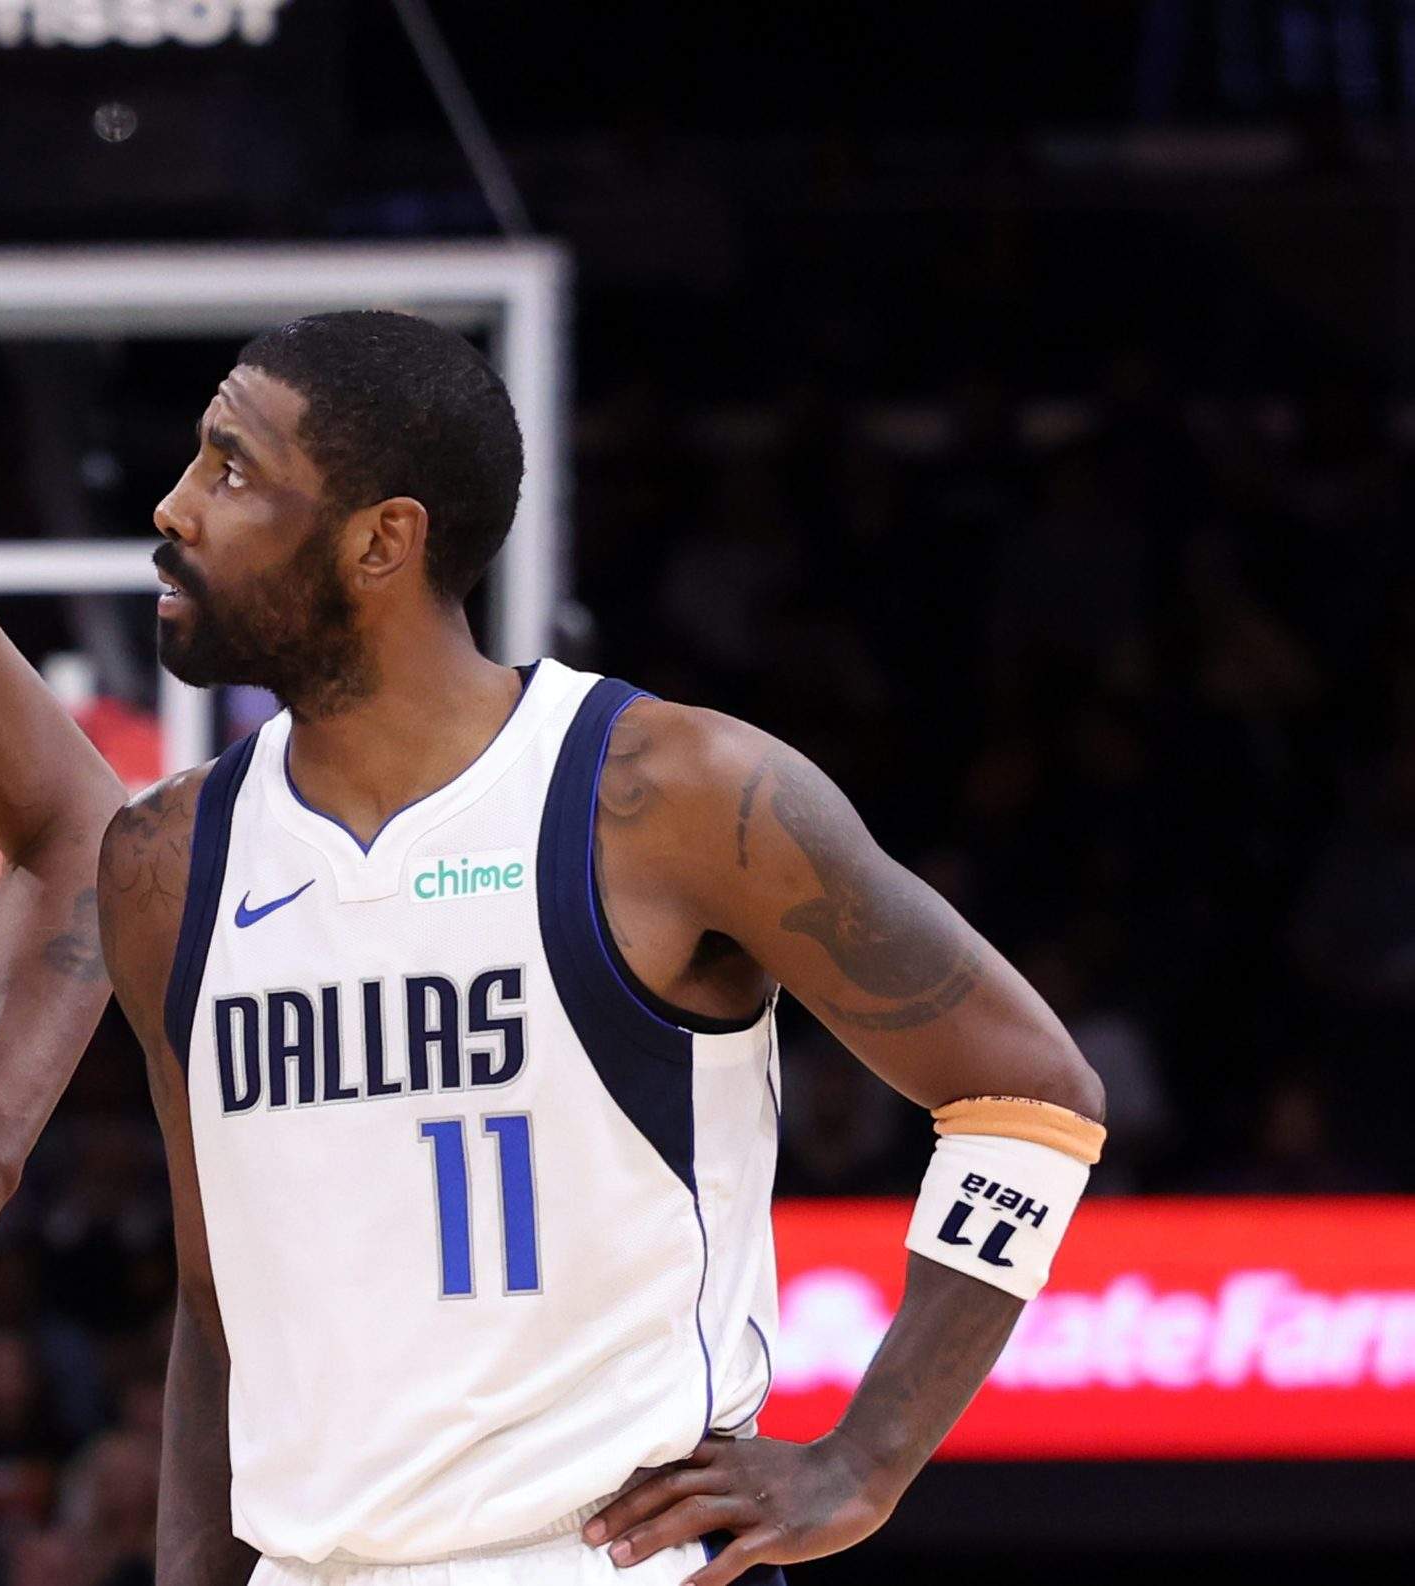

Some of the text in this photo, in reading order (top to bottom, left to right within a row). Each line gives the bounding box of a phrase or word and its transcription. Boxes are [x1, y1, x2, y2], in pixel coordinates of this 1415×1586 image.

[413, 858, 524, 899] chime
[212, 964, 529, 1118] DALLAS
[417, 1110, 543, 1301] 11
